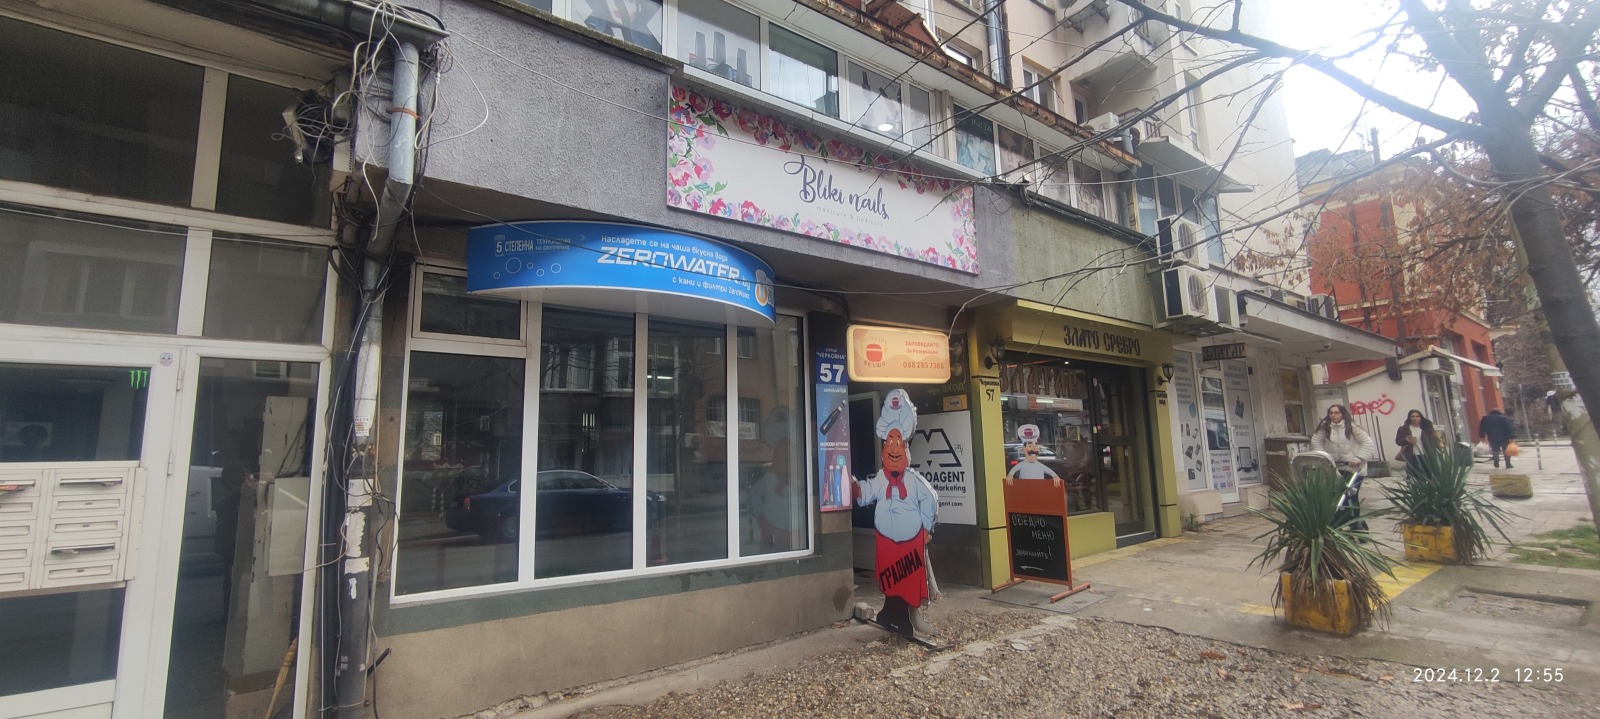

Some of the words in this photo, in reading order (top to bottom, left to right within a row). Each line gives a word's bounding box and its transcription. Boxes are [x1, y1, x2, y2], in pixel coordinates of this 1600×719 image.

[783, 154, 845, 205] Bliki
[848, 187, 890, 220] nails
[495, 241, 503, 253] 5
[504, 239, 534, 253] СТЕПЕННА
[601, 235, 647, 247] Насладете
[671, 245, 691, 253] чаша
[691, 245, 714, 260] вкусна
[678, 276, 696, 287] кани
[703, 280, 728, 293] филтри
[1063, 325, 1100, 350] ЗЛАТО
[1103, 332, 1141, 356] СРЕБРО
[820, 363, 844, 383] 57
[902, 361, 917, 369] 088
[986, 388, 995, 402] 57
[933, 484, 967, 493] Marketing
[1011, 513, 1046, 528] ОБЕДНО
[1031, 530, 1055, 541] МЕНЮ
[879, 548, 923, 593] ГРАДИНА
